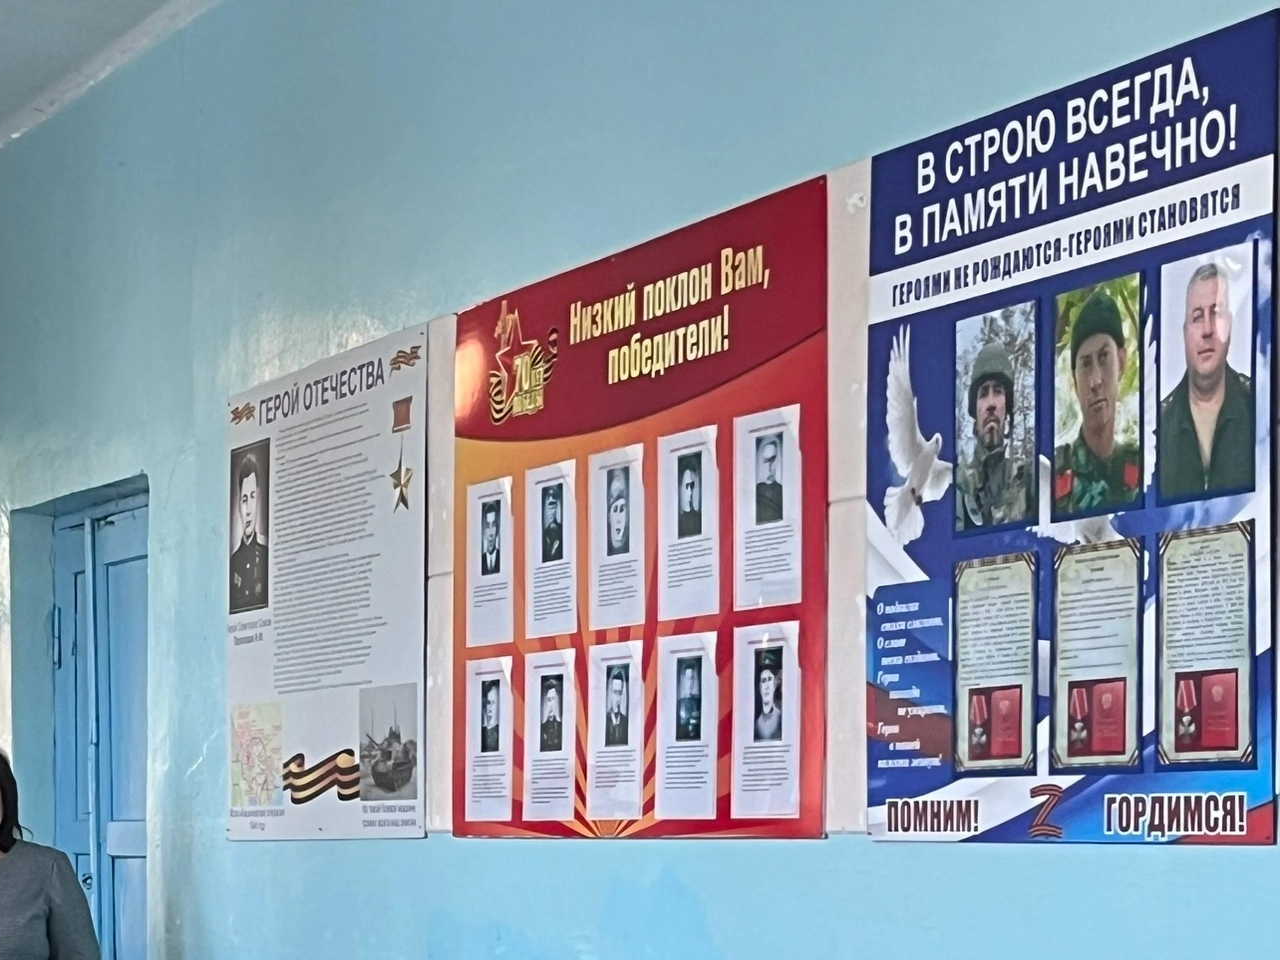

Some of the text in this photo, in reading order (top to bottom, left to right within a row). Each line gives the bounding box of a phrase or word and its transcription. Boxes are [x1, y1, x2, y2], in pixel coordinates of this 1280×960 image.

[917, 56, 1210, 195] В СТРОЮ ВСЕГДА,
[894, 103, 1237, 255] В ПАМЯТИ НАВЕЧНО!
[892, 269, 951, 308] ГЕРОЯМИ
[954, 266, 970, 290] НЕ
[1138, 183, 1241, 238] СТАНОВЯТСЯ
[569, 245, 770, 345] Низкий поклон Вам,
[608, 304, 730, 385] победители!
[258, 357, 385, 426] ГЕРОЙ ОТЕЧЕСТВА
[886, 799, 980, 833] ПОМНИМ!
[1106, 795, 1246, 838] ГОРДИМСЯ!
